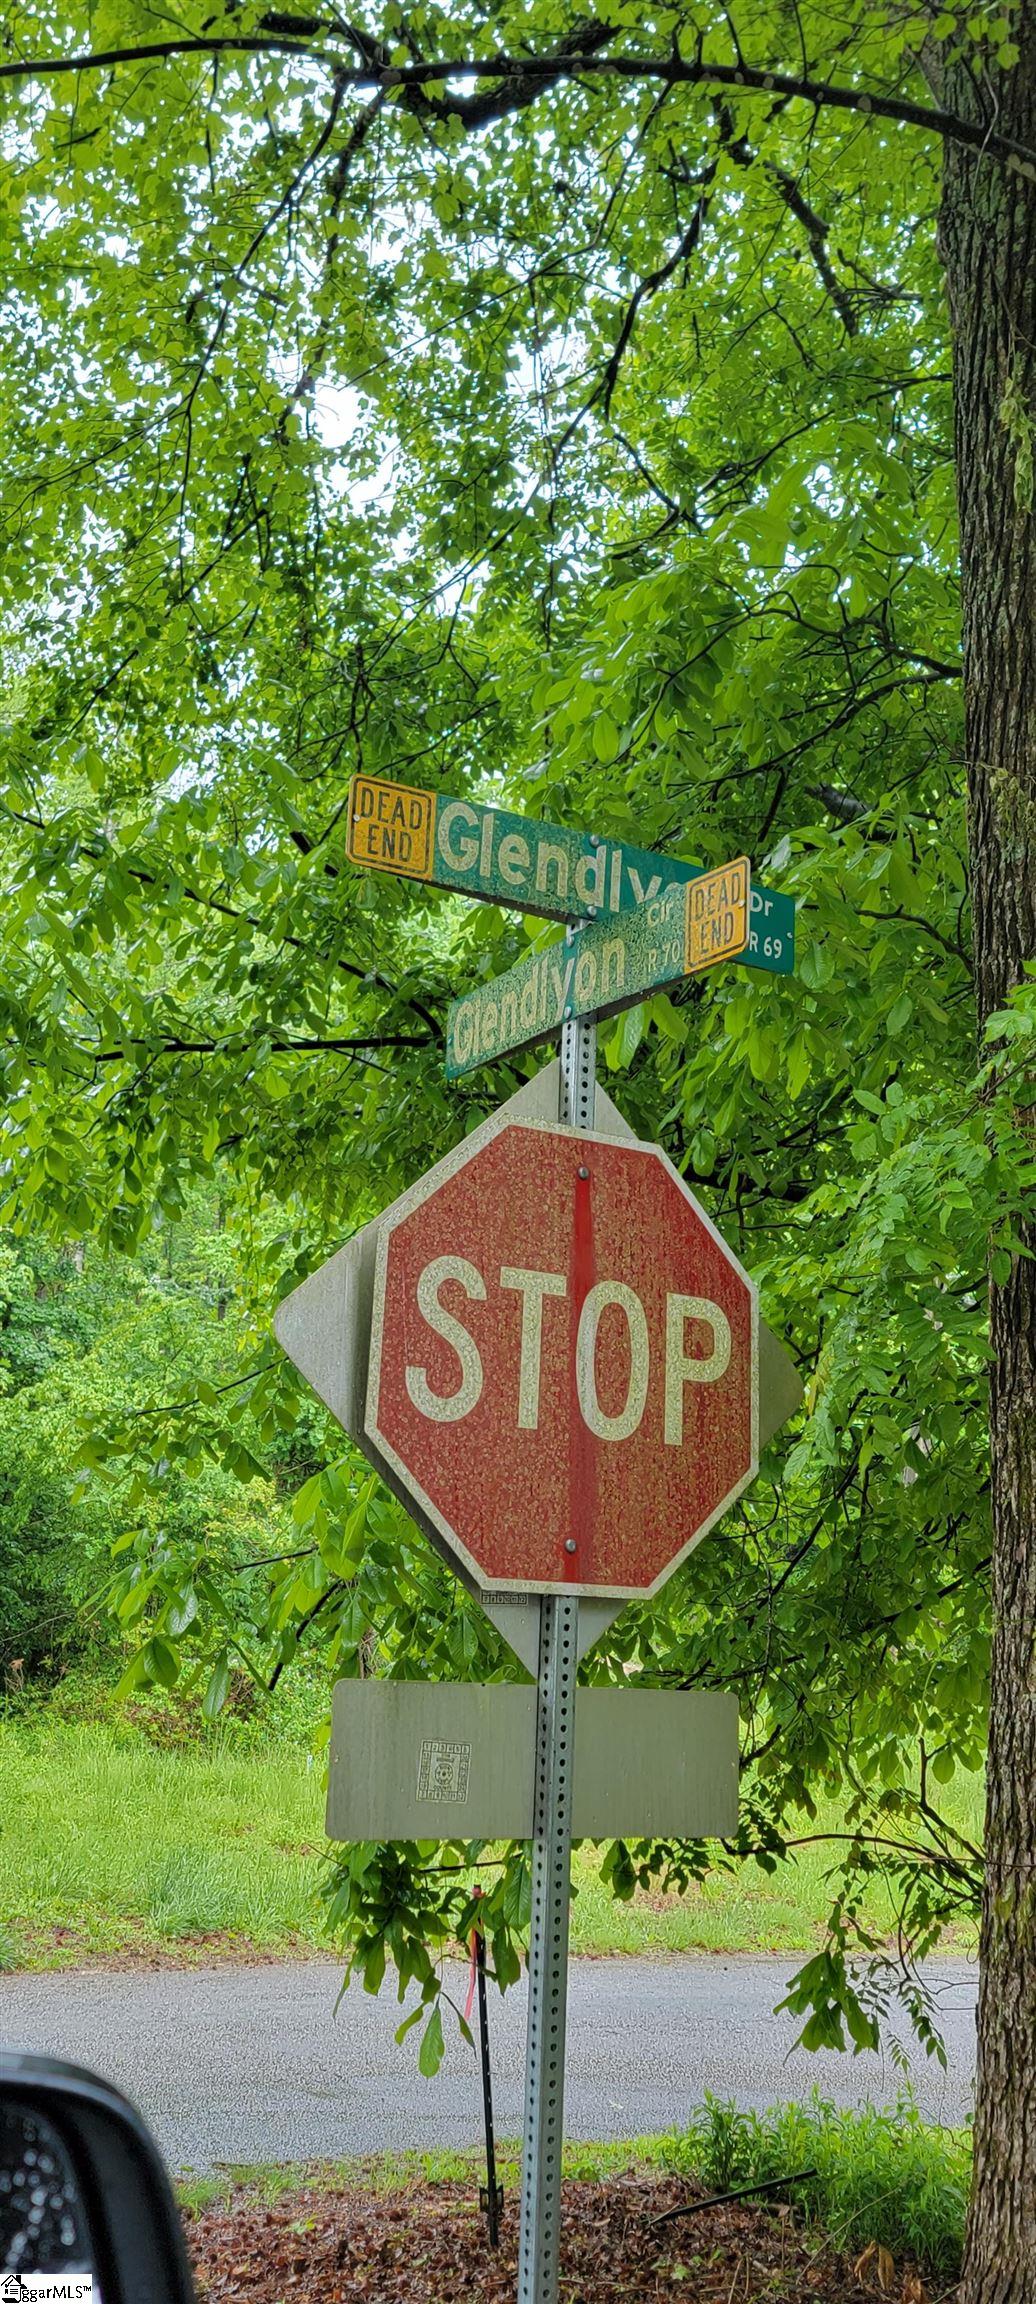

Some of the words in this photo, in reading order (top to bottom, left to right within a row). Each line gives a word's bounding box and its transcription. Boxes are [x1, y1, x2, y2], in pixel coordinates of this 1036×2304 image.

[360, 786, 423, 831] DEAD
[366, 823, 412, 863] END
[437, 801, 686, 914] Glendly
[750, 890, 774, 917] Dr
[694, 871, 741, 921] DEAD
[699, 911, 734, 954] END
[763, 936, 783, 960] 69
[648, 948, 657, 973] R
[662, 938, 681, 966] 70
[453, 937, 626, 1065] Glendlyon
[647, 899, 674, 929] Cir
[405, 1254, 732, 1447] STOP
